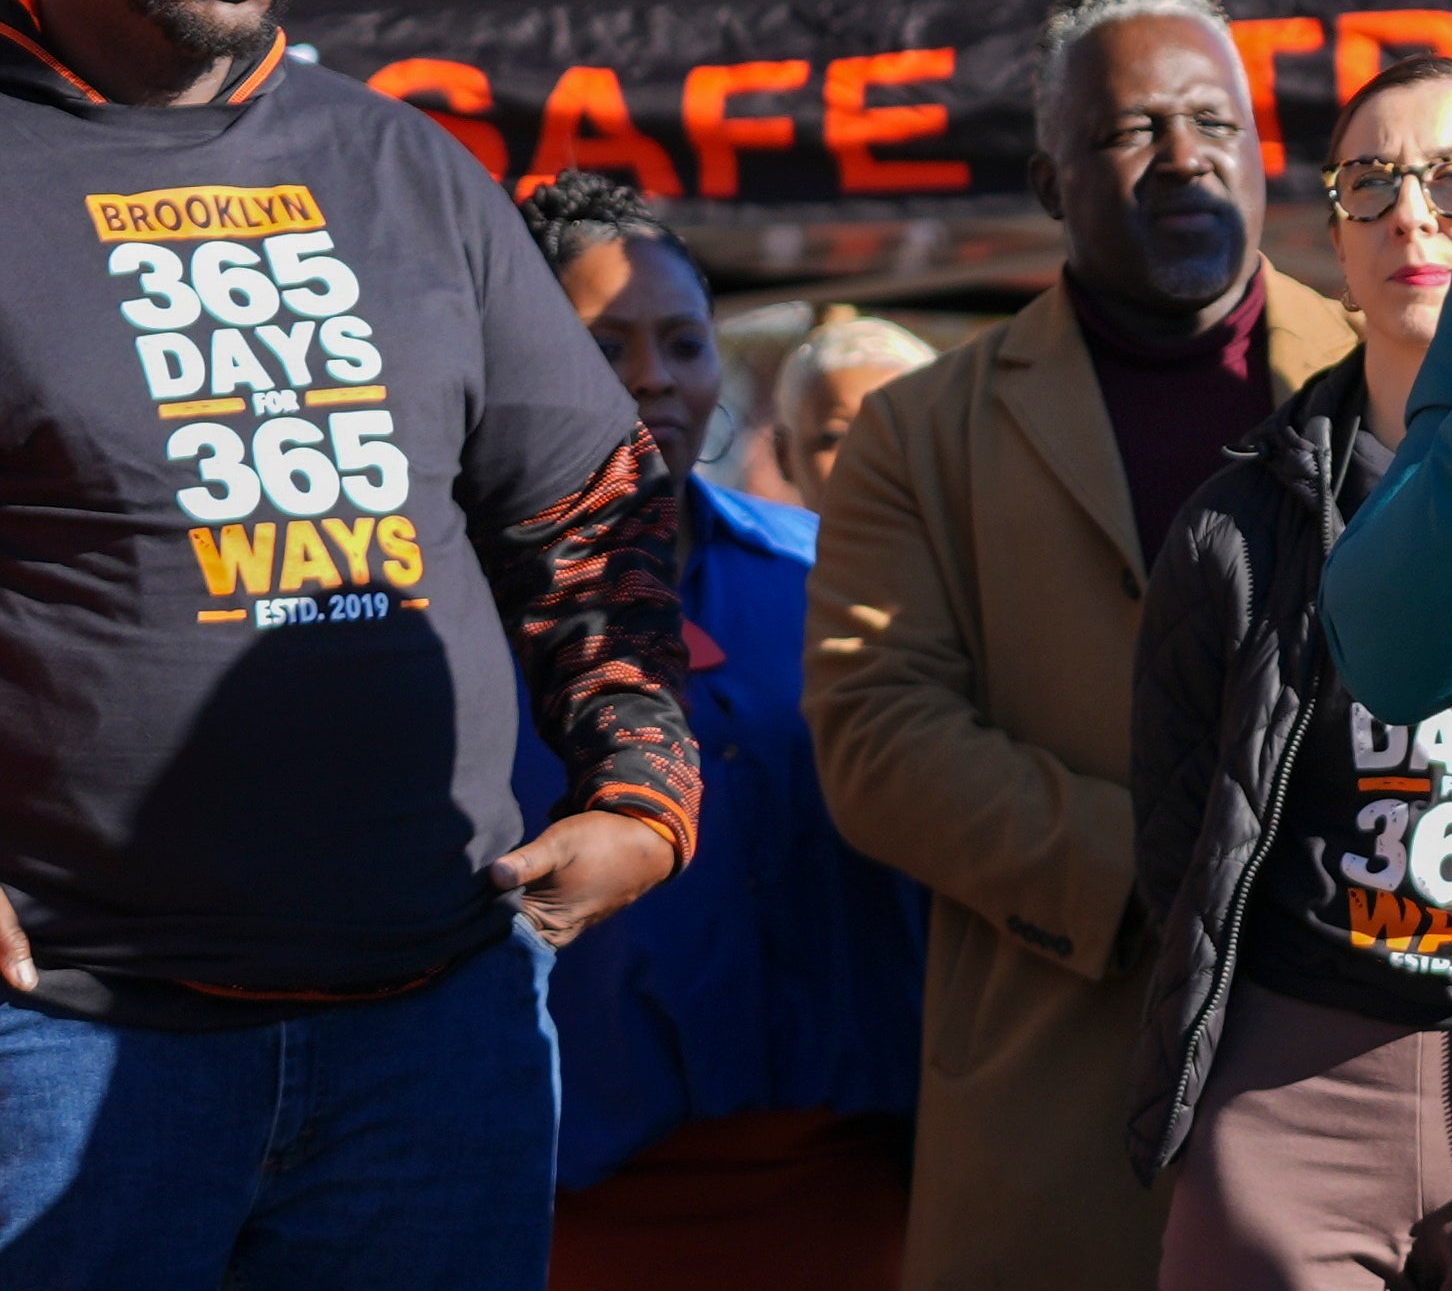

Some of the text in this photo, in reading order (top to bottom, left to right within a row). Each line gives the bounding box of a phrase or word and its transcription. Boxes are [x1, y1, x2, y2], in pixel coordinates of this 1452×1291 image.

[100, 193, 312, 233] BROOKLYN
[108, 230, 360, 331] 365
[135, 316, 382, 400] DAYS
[251, 389, 299, 416] FOR
[167, 410, 409, 522] 365
[189, 515, 424, 597] WAYS
[255, 593, 389, 628] ESTD. 2019
